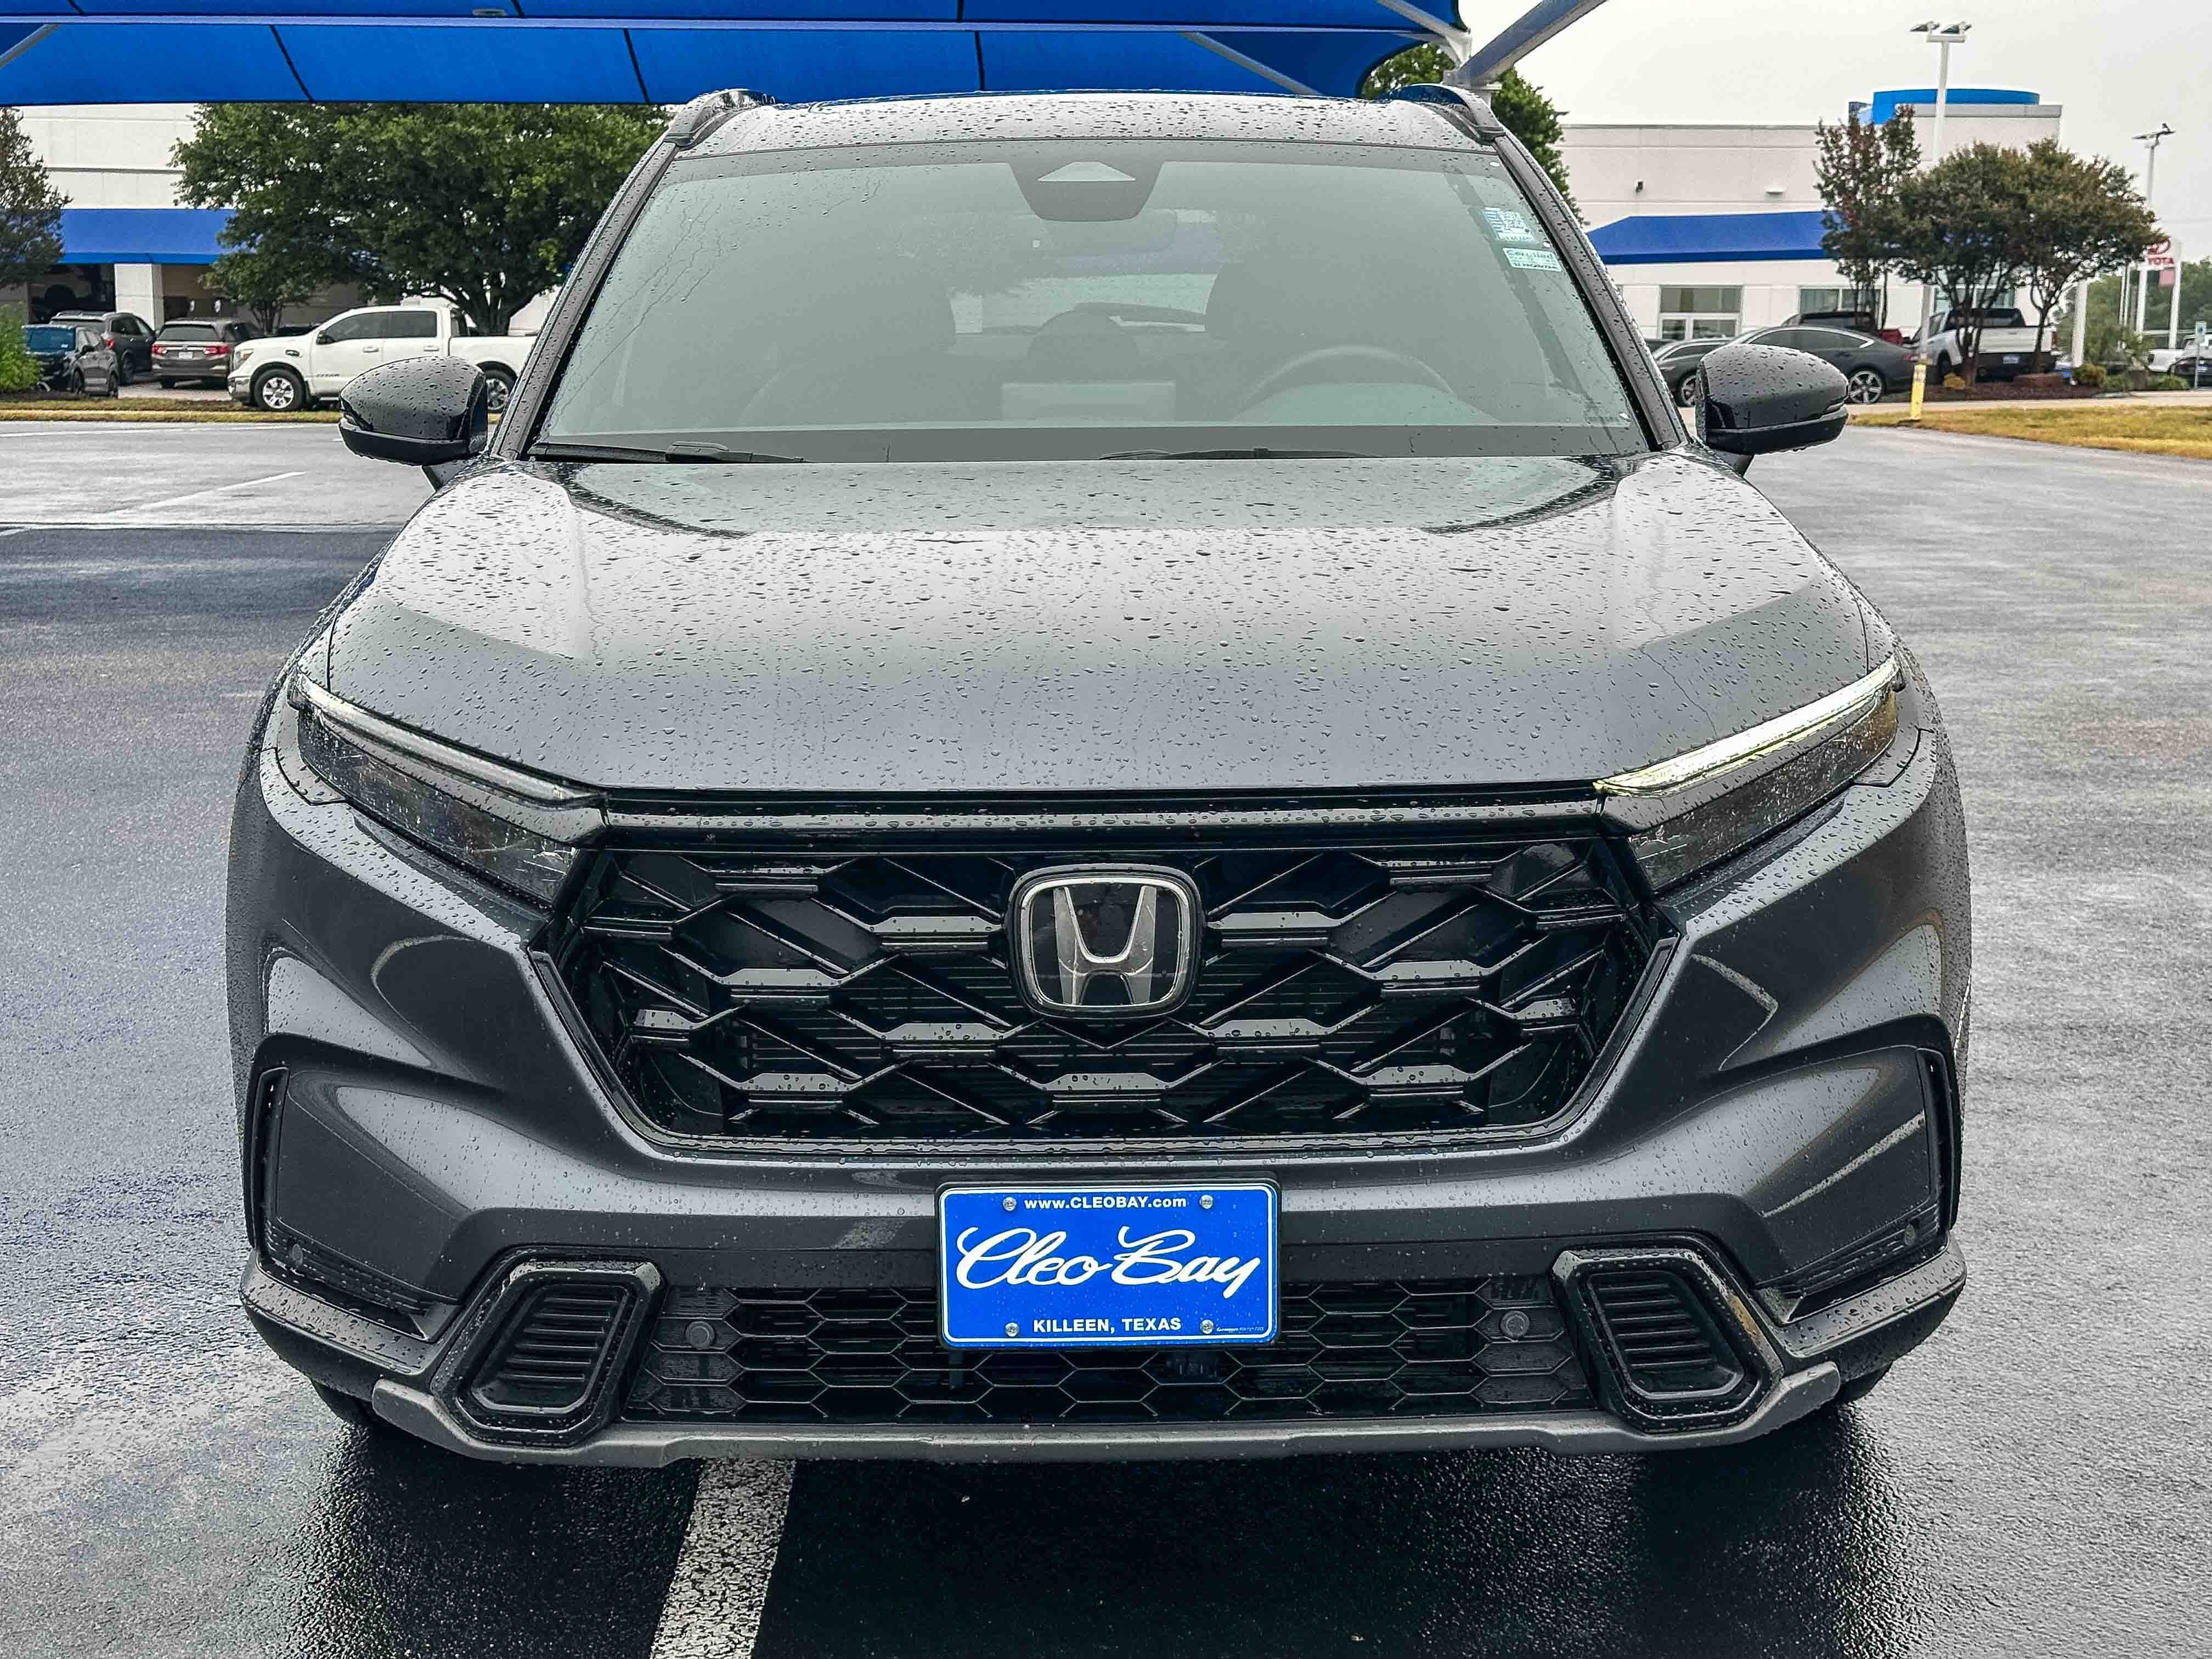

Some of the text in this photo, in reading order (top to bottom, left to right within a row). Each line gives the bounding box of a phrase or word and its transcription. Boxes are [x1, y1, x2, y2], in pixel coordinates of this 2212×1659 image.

[1024, 1195, 1187, 1209] www.CLEOBAY.com
[956, 1225, 1261, 1300] Cleo Bay
[1032, 1317, 1182, 1334] KILLEEN, TEXAS
